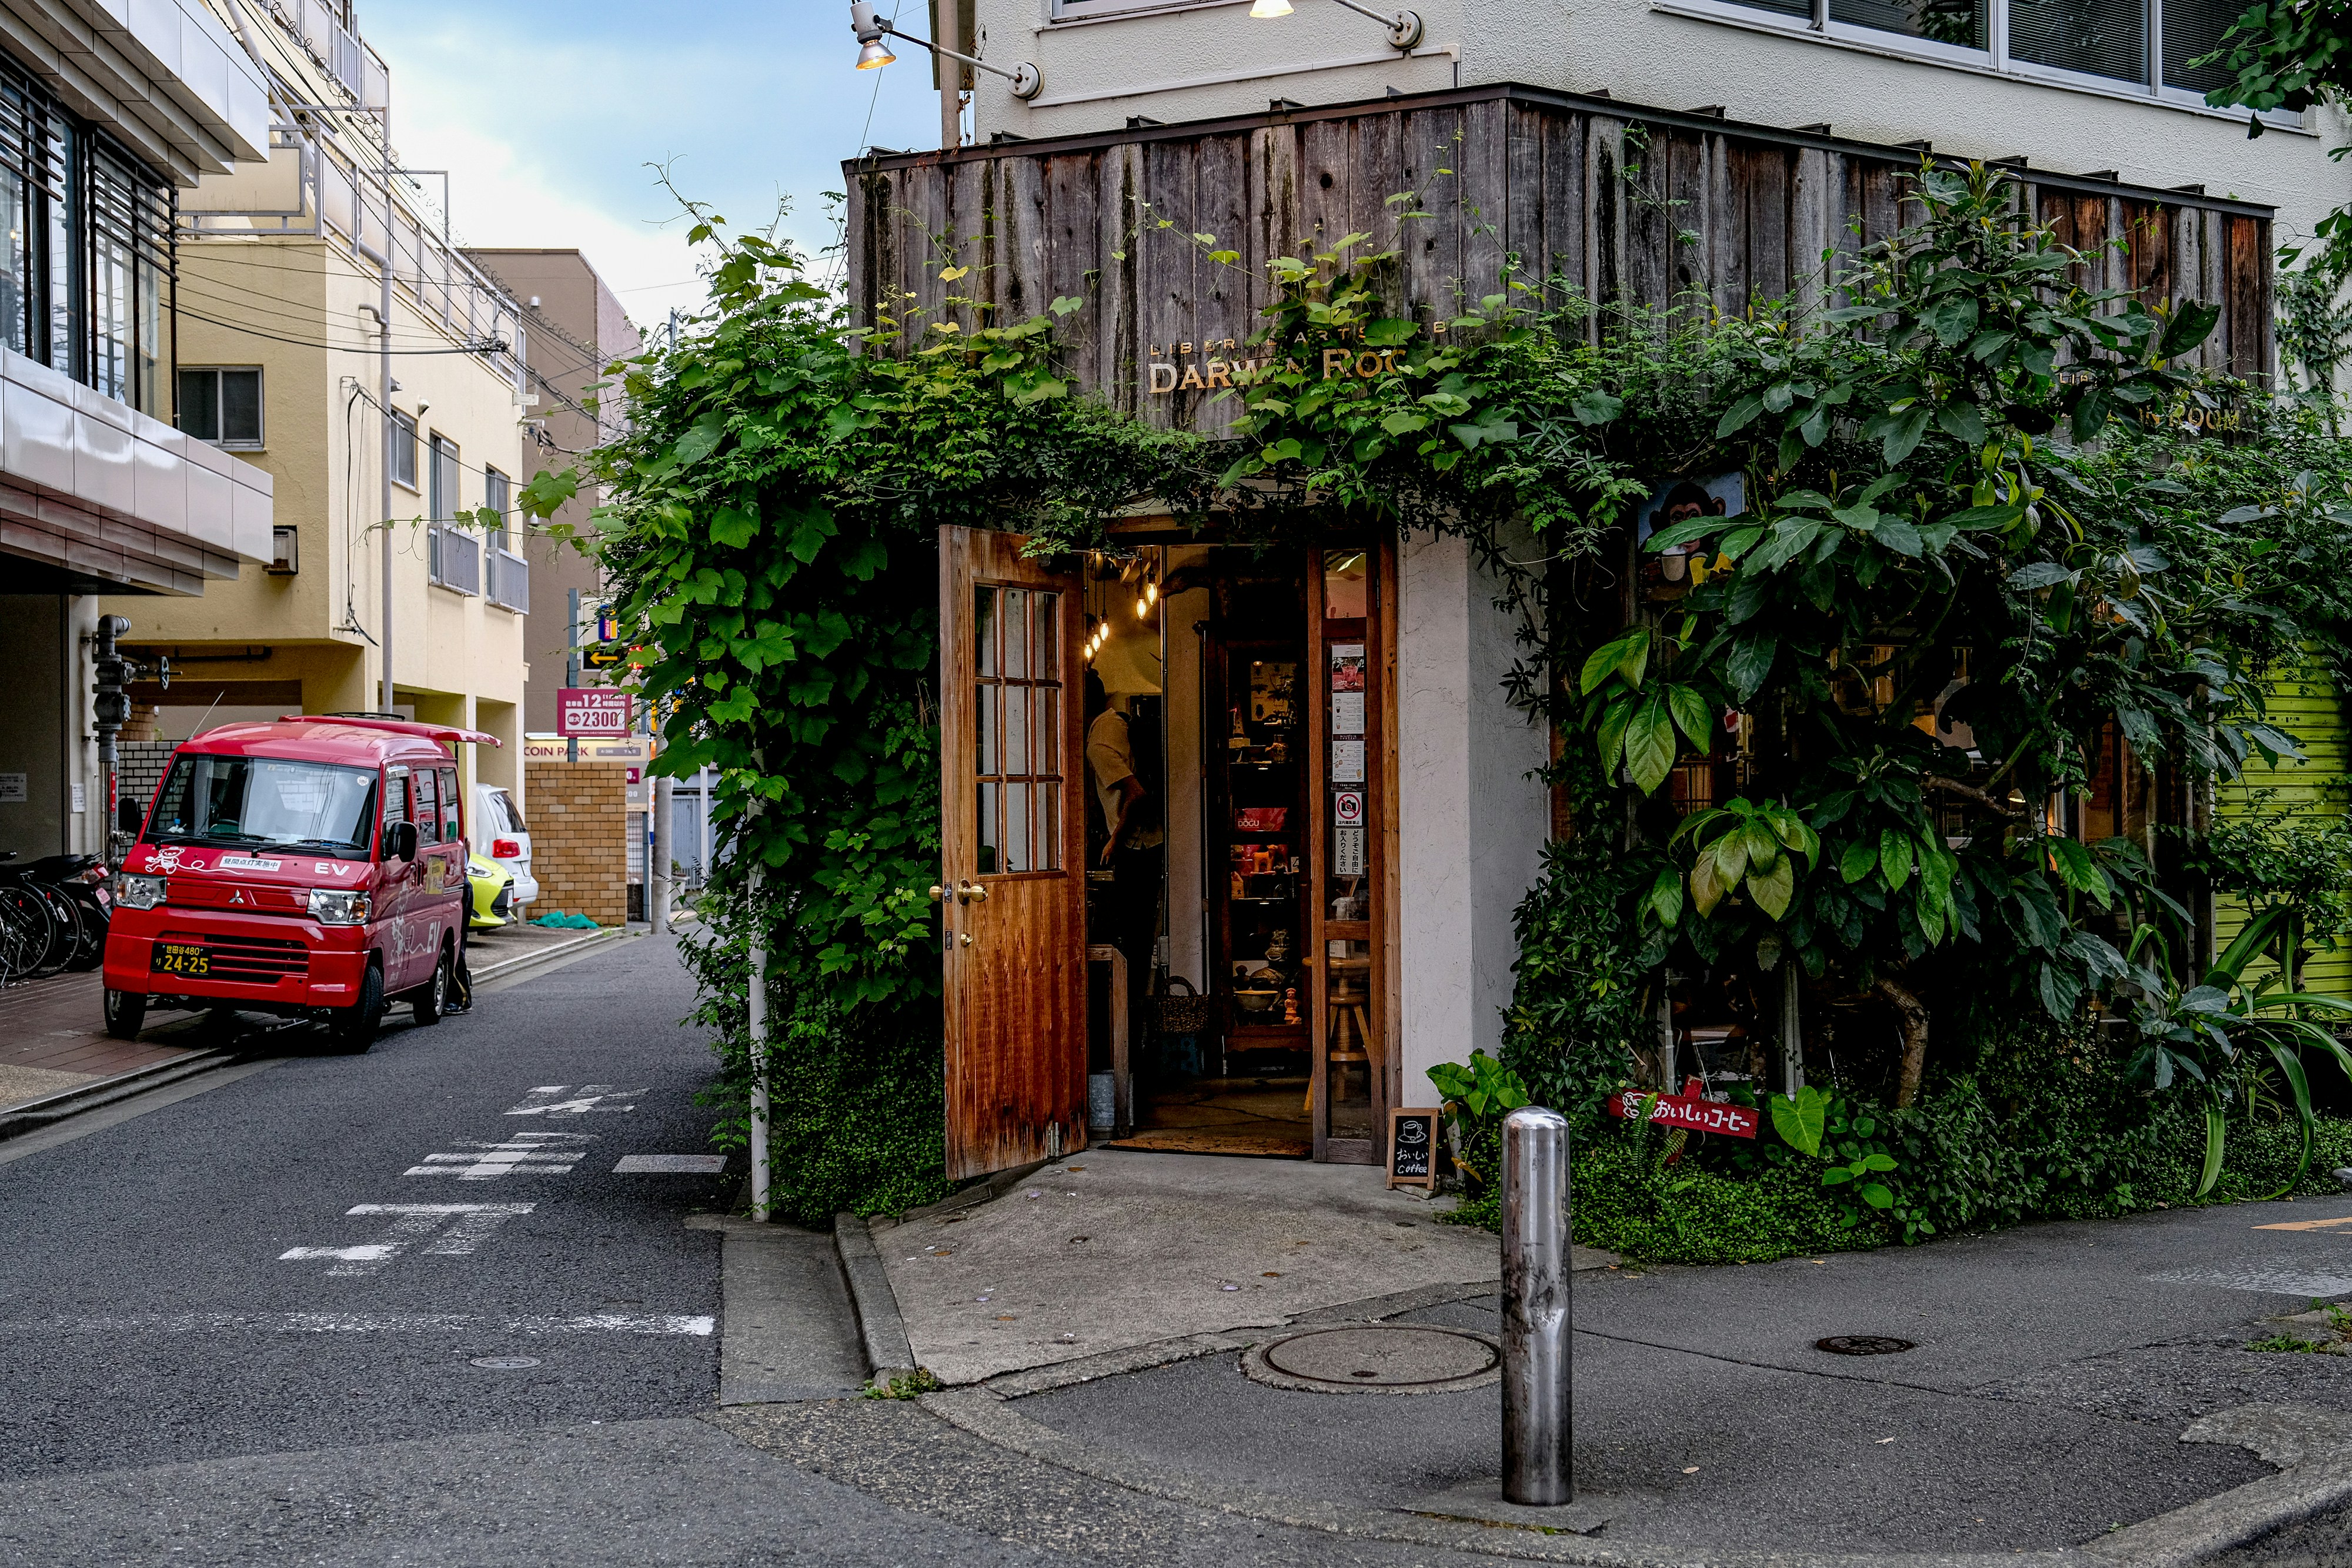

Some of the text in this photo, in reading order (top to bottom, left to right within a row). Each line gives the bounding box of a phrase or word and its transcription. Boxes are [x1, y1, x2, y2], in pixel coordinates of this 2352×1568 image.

[524, 747, 553, 756] COIN
[223, 857, 279, 868] 昼間点灯実施中
[315, 862, 350, 876] EV
[163, 954, 209, 974] 24-25
[1653, 1099, 1750, 1132] おいしいコーヒー
[1396, 1148, 1428, 1161] おいしい
[1397, 1164, 1427, 1174] Coffee
